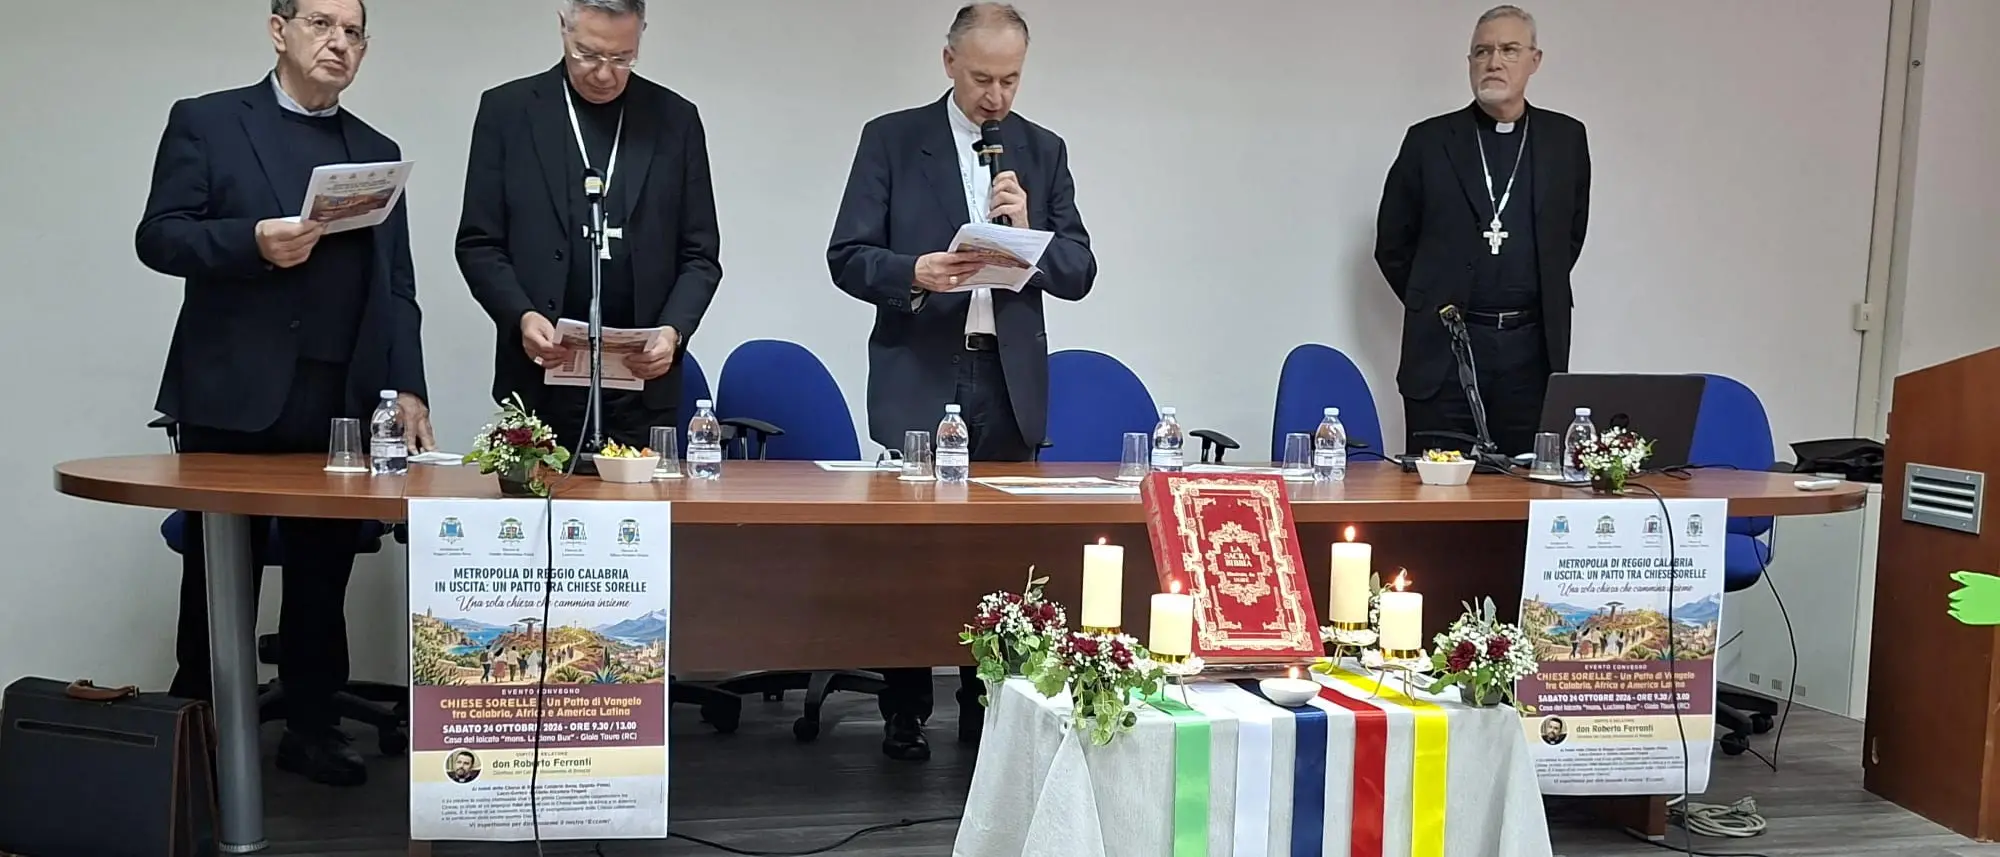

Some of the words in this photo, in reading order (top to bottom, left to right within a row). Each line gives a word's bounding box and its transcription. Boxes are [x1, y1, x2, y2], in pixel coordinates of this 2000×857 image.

[1558, 558, 1608, 568] METROPOLIA
[1610, 558, 1620, 568] DI
[1622, 558, 1652, 568] REGGIO
[454, 568, 519, 579] METROPOLIA
[522, 568, 534, 579] DI
[578, 568, 629, 580] CALABRIA
[1543, 570, 1552, 580] IN
[1554, 570, 1584, 580] USCITA:
[1587, 570, 1598, 580] UN
[1600, 570, 1624, 580] PATTO
[1627, 570, 1642, 579] TRA
[1644, 569, 1672, 579] CHIESE
[1673, 568, 1707, 578] SORELLE
[435, 582, 446, 592] IN
[449, 582, 489, 592] USCITA:
[492, 582, 506, 592] UN
[510, 582, 541, 592] PATTO
[567, 582, 602, 592] CHIESE
[604, 582, 646, 592] SORELLE
[456, 595, 482, 612] Una
[486, 594, 504, 608] sola
[506, 595, 534, 608] chiesa
[536, 596, 551, 608] ch
[554, 599, 595, 608] cammina
[597, 598, 631, 608] insieme
[1536, 672, 1570, 681] CHIESE
[1572, 672, 1612, 680] SORELLE
[1620, 672, 1632, 680] Un
[1664, 672, 1695, 681] Vngelo
[440, 698, 482, 708] CHIESE
[486, 698, 537, 708] SORELLE
[546, 698, 560, 707] Un
[564, 696, 590, 706] Patto
[592, 696, 600, 706] di
[604, 696, 642, 708] Vangelo
[1538, 694, 1568, 702] SABATO
[1578, 694, 1614, 702] OTTOBRE
[1636, 693, 1652, 701] ORE
[1674, 692, 1690, 700] 3.00
[452, 710, 466, 719] tra
[469, 708, 514, 718] Calabria,
[556, 707, 596, 716] America
[600, 706, 630, 716] Latina
[442, 724, 482, 734] SABATO
[484, 724, 494, 733] 24
[544, 722, 562, 732] 2026
[570, 722, 590, 730] ORE
[592, 722, 608, 730] 9.30
[616, 721, 637, 730] 13.00
[1576, 725, 1590, 733] don
[1592, 724, 1622, 733] Roberto
[1624, 724, 1654, 732] Ferranti
[464, 735, 474, 743] del
[527, 734, 556, 742] Luiano
[580, 733, 598, 741] Gioia
[600, 732, 620, 740] Tauro
[621, 732, 638, 740] (RC)
[492, 760, 510, 768] don
[514, 758, 550, 768] Roberto
[554, 757, 592, 767] Ferranti
